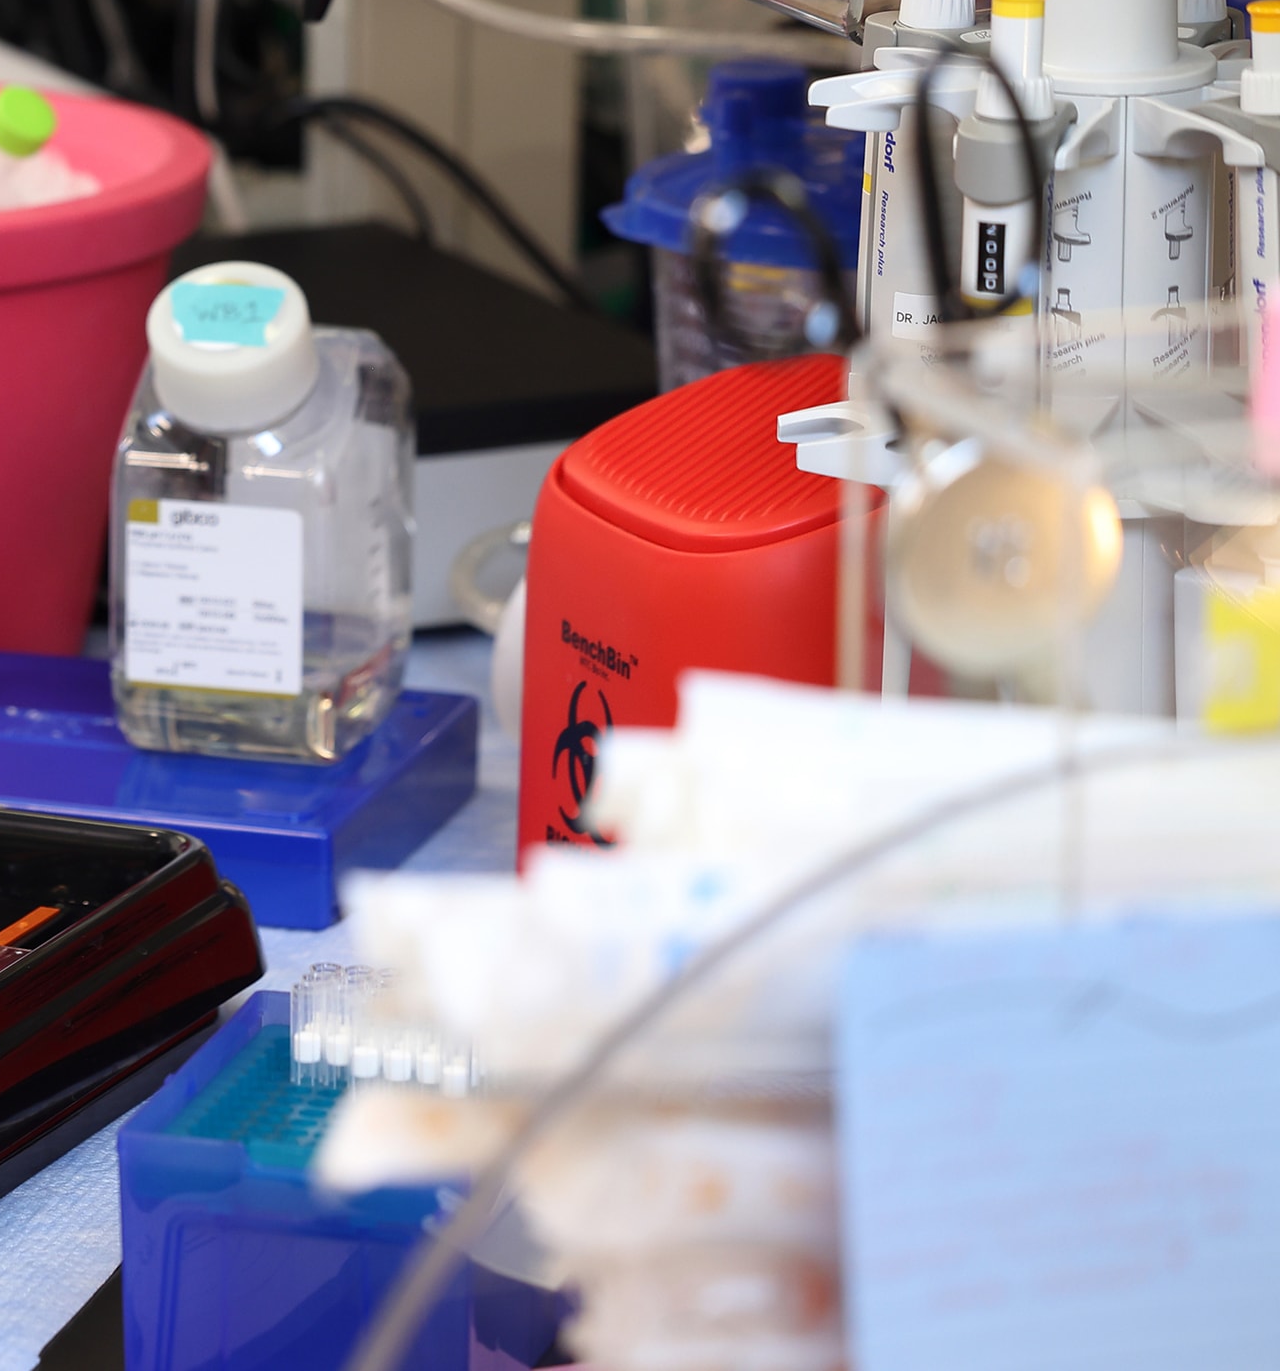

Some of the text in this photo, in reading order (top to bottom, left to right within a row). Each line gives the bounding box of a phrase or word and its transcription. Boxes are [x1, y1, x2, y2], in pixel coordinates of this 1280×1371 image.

[1157, 183, 1195, 215] Reference
[876, 189, 890, 277] Research plus
[1255, 197, 1266, 259] Research
[1151, 335, 1190, 368] Research
